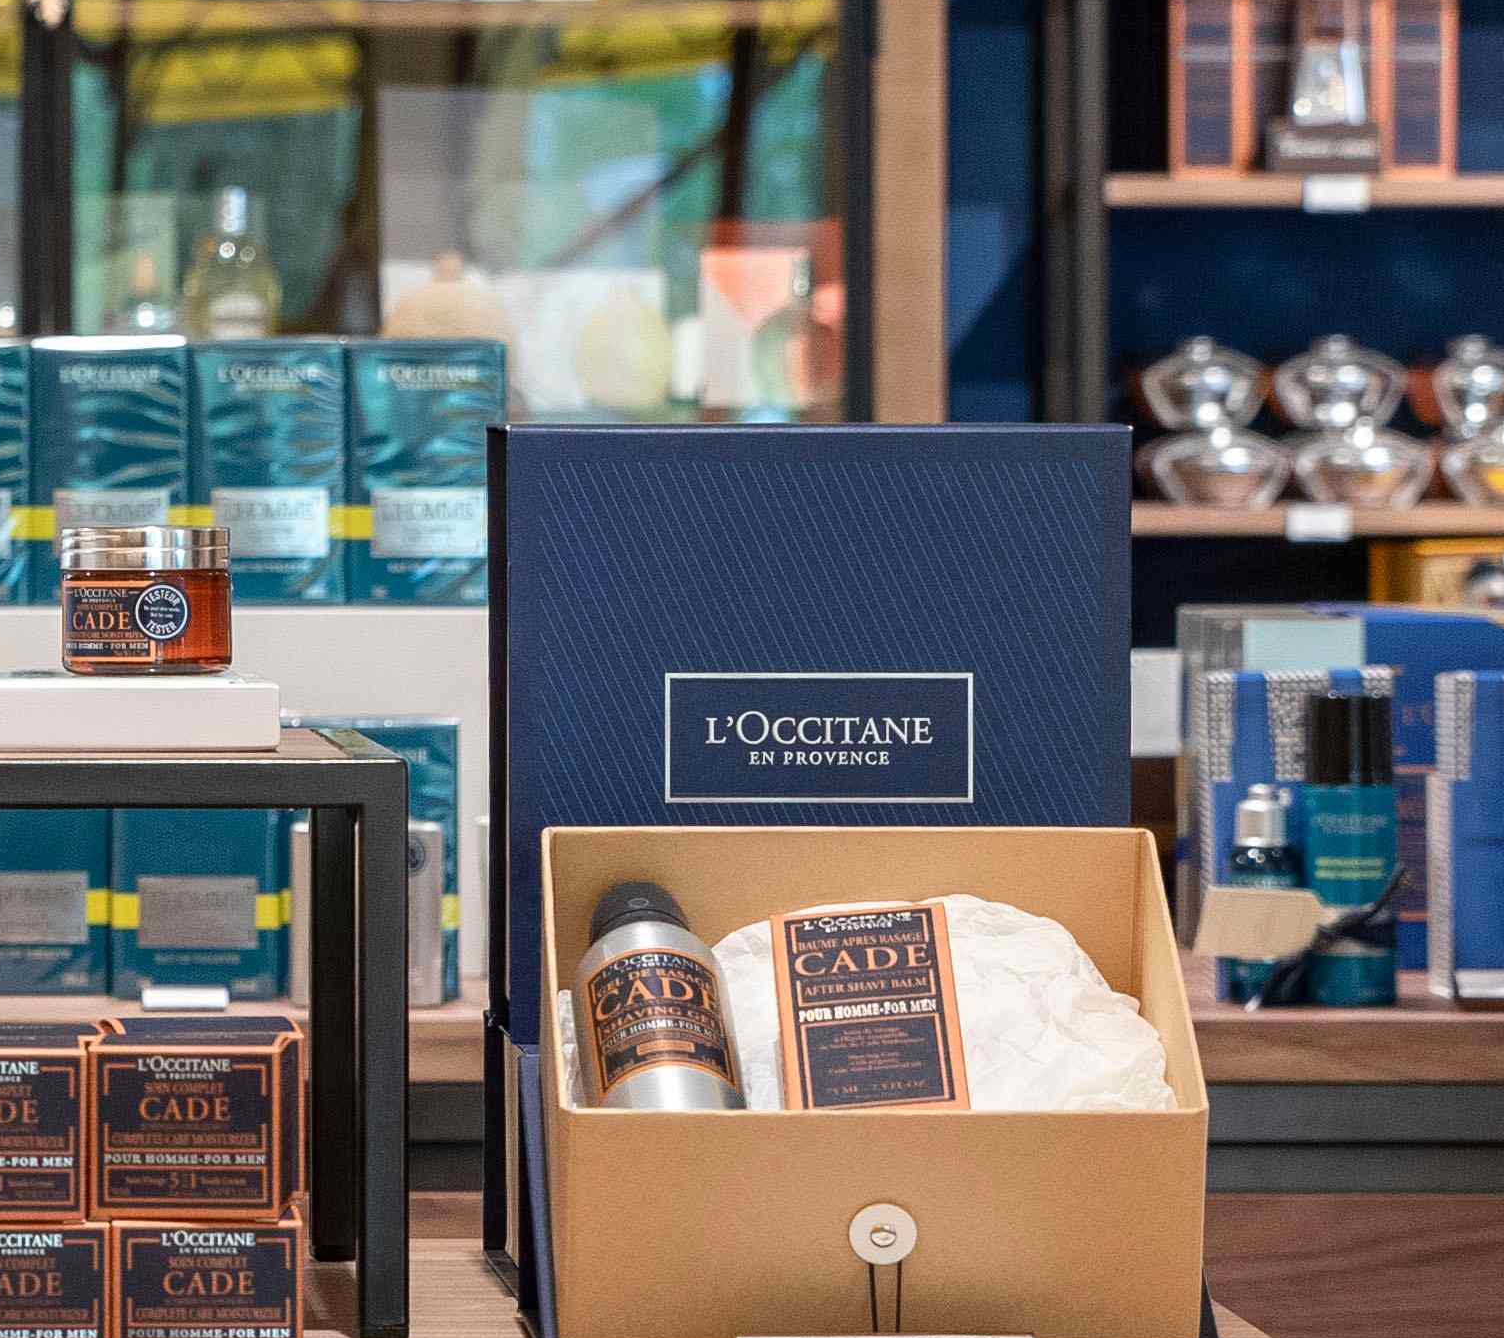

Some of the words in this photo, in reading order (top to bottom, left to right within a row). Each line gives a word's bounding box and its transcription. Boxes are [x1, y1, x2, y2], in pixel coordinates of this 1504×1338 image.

[73, 588, 128, 598] L'OCCITANE
[144, 589, 181, 606] TESTEUR
[73, 612, 131, 630] CADE
[146, 621, 177, 635] TESTER
[705, 711, 933, 745] L'OCCITANE
[749, 751, 775, 766] EN
[783, 751, 891, 766] PROVENCE
[803, 913, 912, 930] L'OCCITANE
[798, 939, 838, 951] BAUME
[880, 931, 923, 944] RASAGE
[794, 944, 932, 976] CADE
[804, 984, 844, 997] AFTER
[847, 980, 887, 993] SHAVE
[891, 976, 928, 989] BALM
[798, 1007, 833, 1022] POUR
[910, 998, 937, 1012] MEN
[137, 1056, 232, 1072] L'OCCITANE
[139, 1097, 231, 1121] CADE
[42, 1156, 73, 1167] MEN
[104, 1153, 141, 1164] POUR
[145, 1153, 230, 1165] HOMME-FOR
[235, 1154, 266, 1164] MEN
[161, 1230, 256, 1247] L'OCCITANE
[163, 1271, 255, 1295] CADE
[67, 1329, 97, 1338] MEN
[128, 1328, 165, 1338] POUR
[169, 1328, 255, 1338] HOMME-FOR
[259, 1328, 290, 1338] MEN
